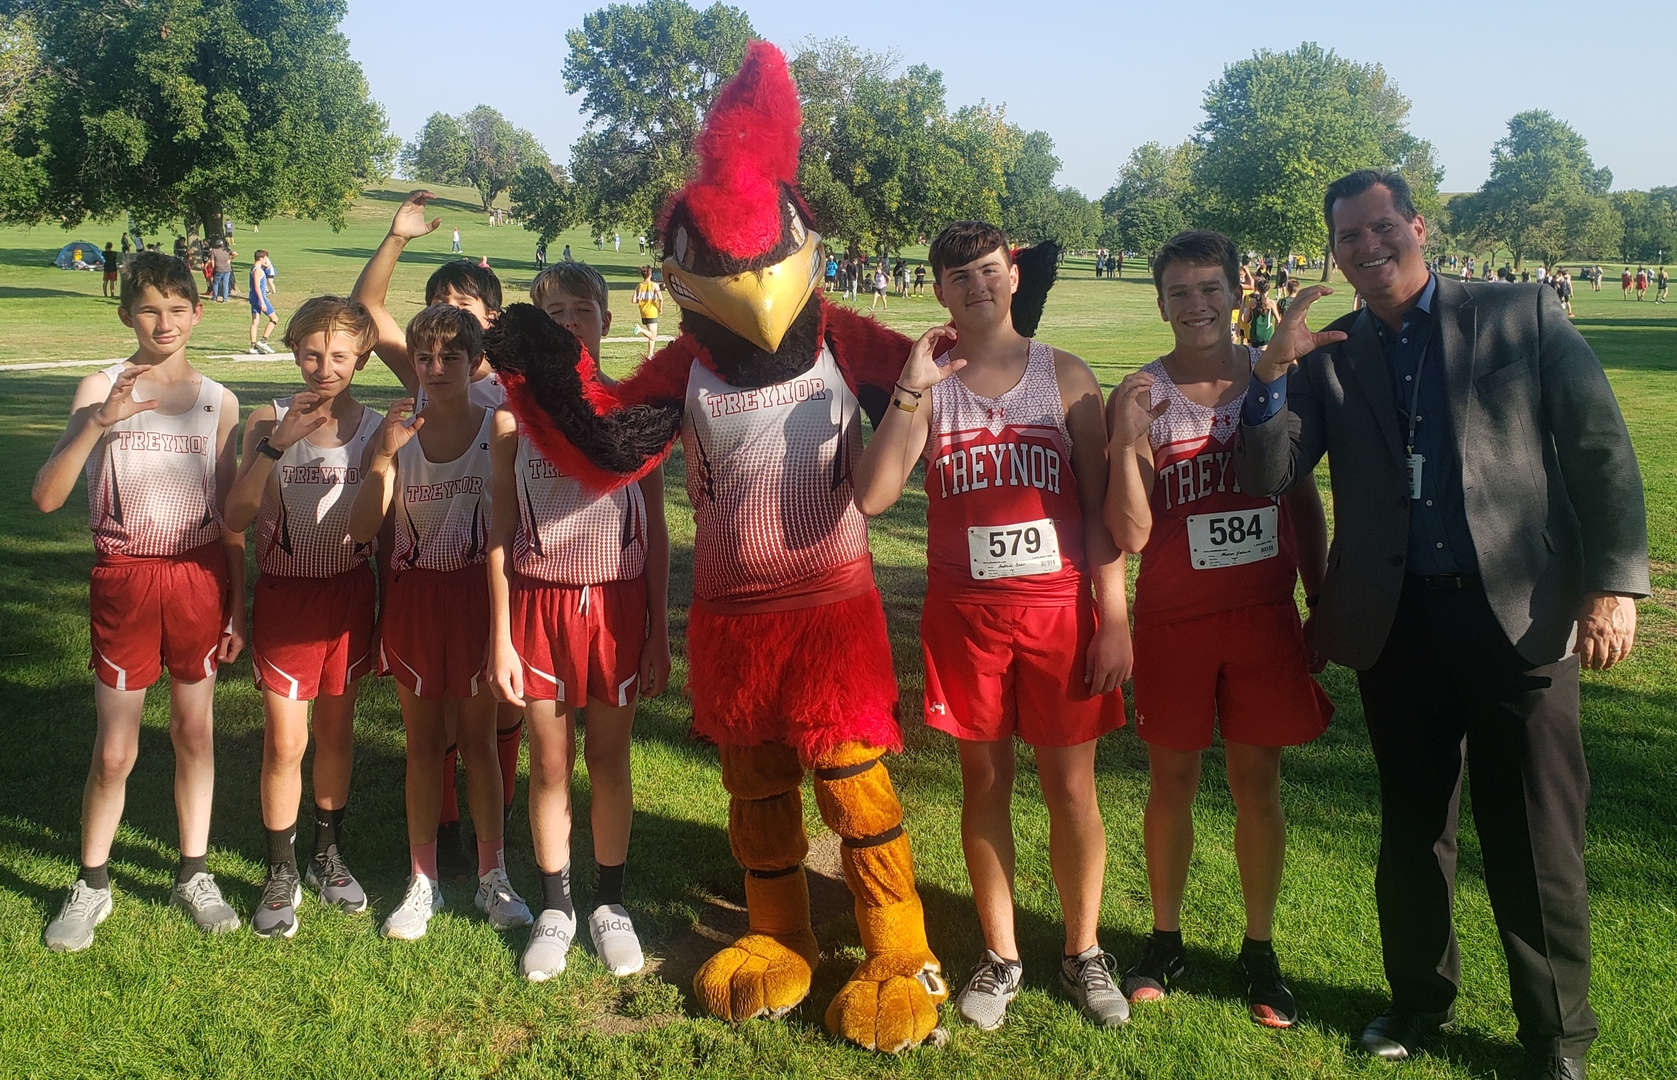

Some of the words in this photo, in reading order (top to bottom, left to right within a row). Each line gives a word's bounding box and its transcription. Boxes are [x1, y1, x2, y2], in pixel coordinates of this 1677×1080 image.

[707, 378, 826, 418] TREYNOR
[283, 465, 360, 484] TREYNO
[935, 443, 1061, 499] TREYNOR
[989, 527, 1041, 558] 579
[1209, 514, 1263, 545] 584
